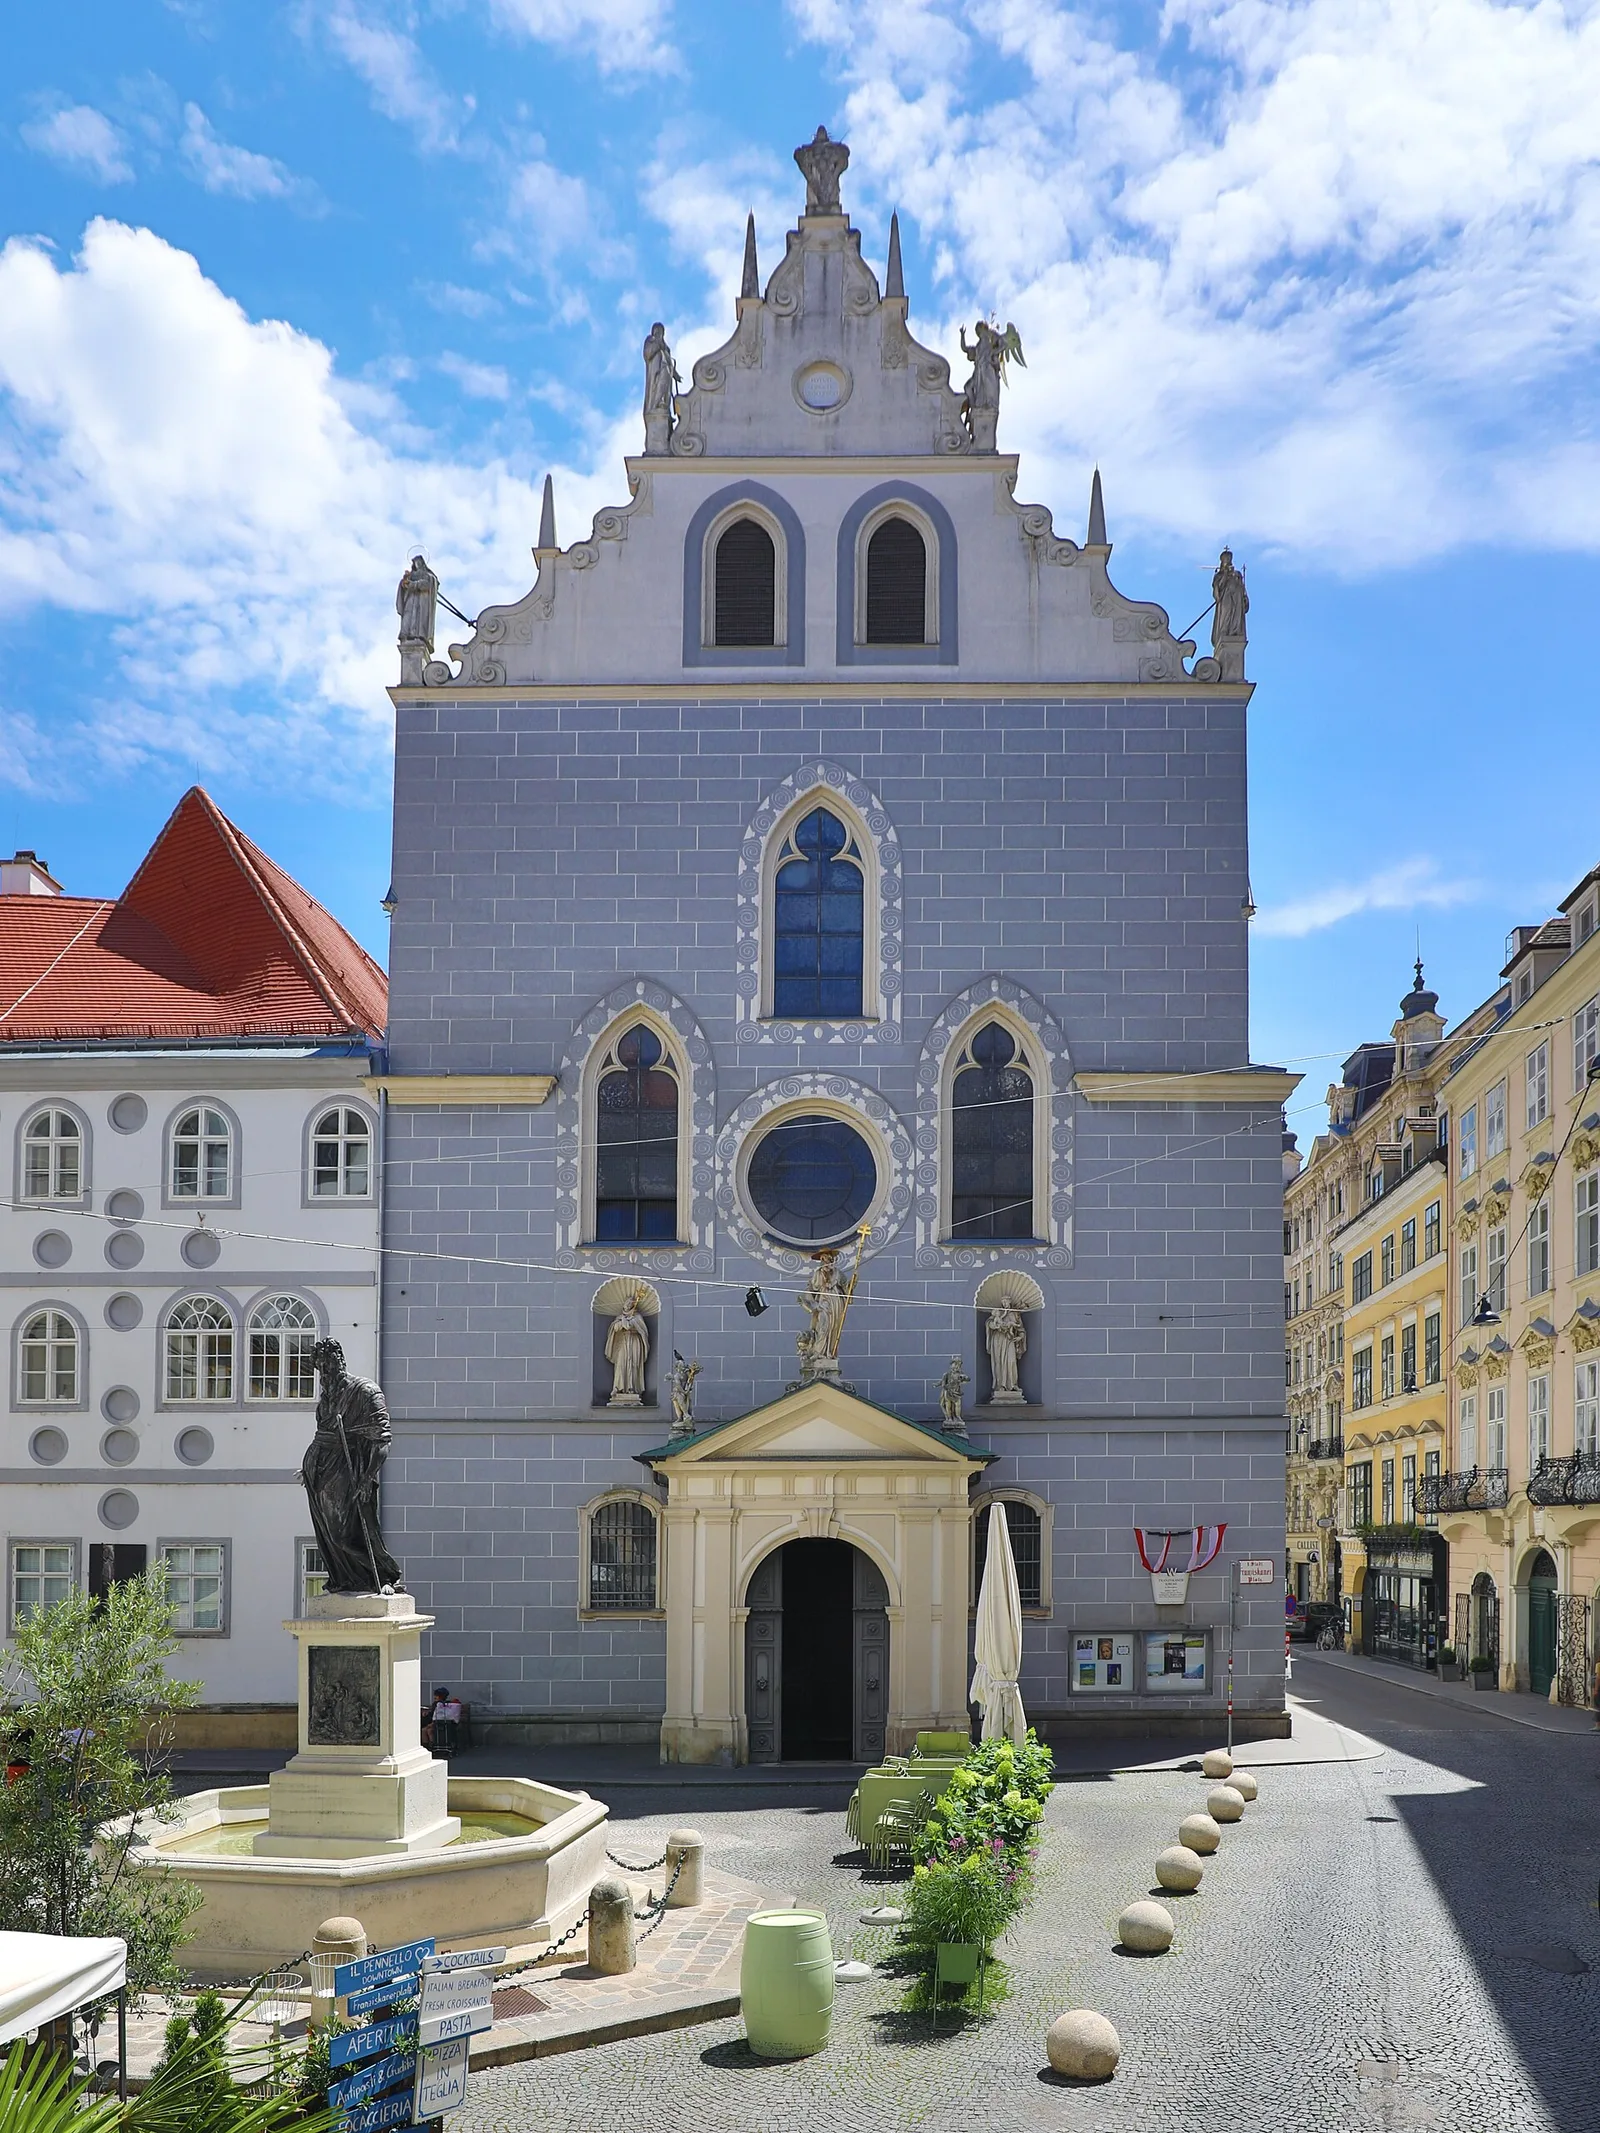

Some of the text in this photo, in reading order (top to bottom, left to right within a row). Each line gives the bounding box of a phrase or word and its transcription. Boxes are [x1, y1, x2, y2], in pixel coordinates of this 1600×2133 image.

[350, 1950, 412, 1977] IL PENNELLO
[444, 1951, 493, 1968] COCKTAILS
[362, 1965, 403, 1985] DOWNTOWN
[427, 1978, 491, 1992] ITALIAN BREAKFAST
[424, 1996, 488, 2011] FRESH CROISSANTS
[440, 2014, 472, 2037] PASTA
[346, 2018, 416, 2057] APERITIVO
[432, 2042, 461, 2063] PIZZA
[436, 2064, 450, 2080] IN
[336, 2074, 376, 2106] Antipasti
[378, 2069, 385, 2083] &
[423, 2079, 459, 2102] TEGLIA
